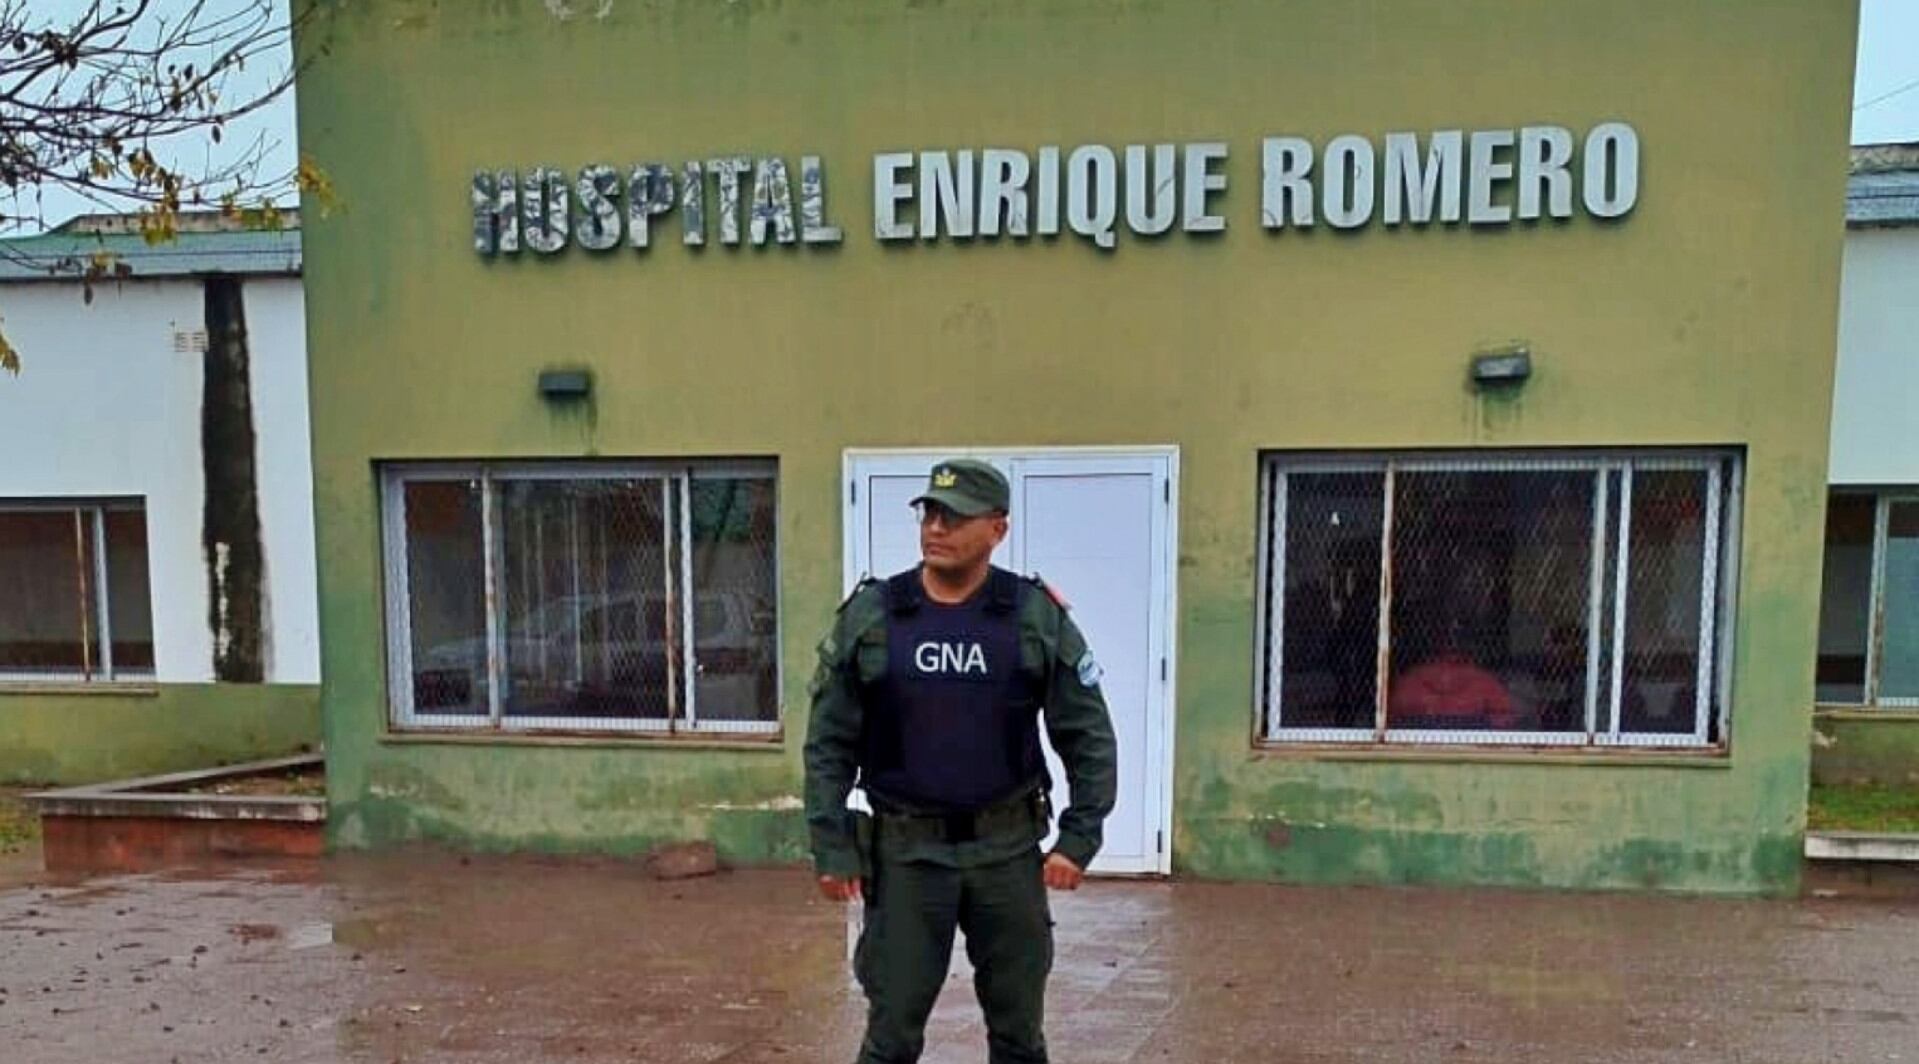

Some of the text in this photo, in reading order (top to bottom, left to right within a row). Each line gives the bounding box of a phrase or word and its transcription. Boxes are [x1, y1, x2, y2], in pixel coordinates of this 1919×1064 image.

[472, 122, 1639, 254] HOSPITAL ENRIQUE ROMERO
[915, 642, 987, 674] GNA
